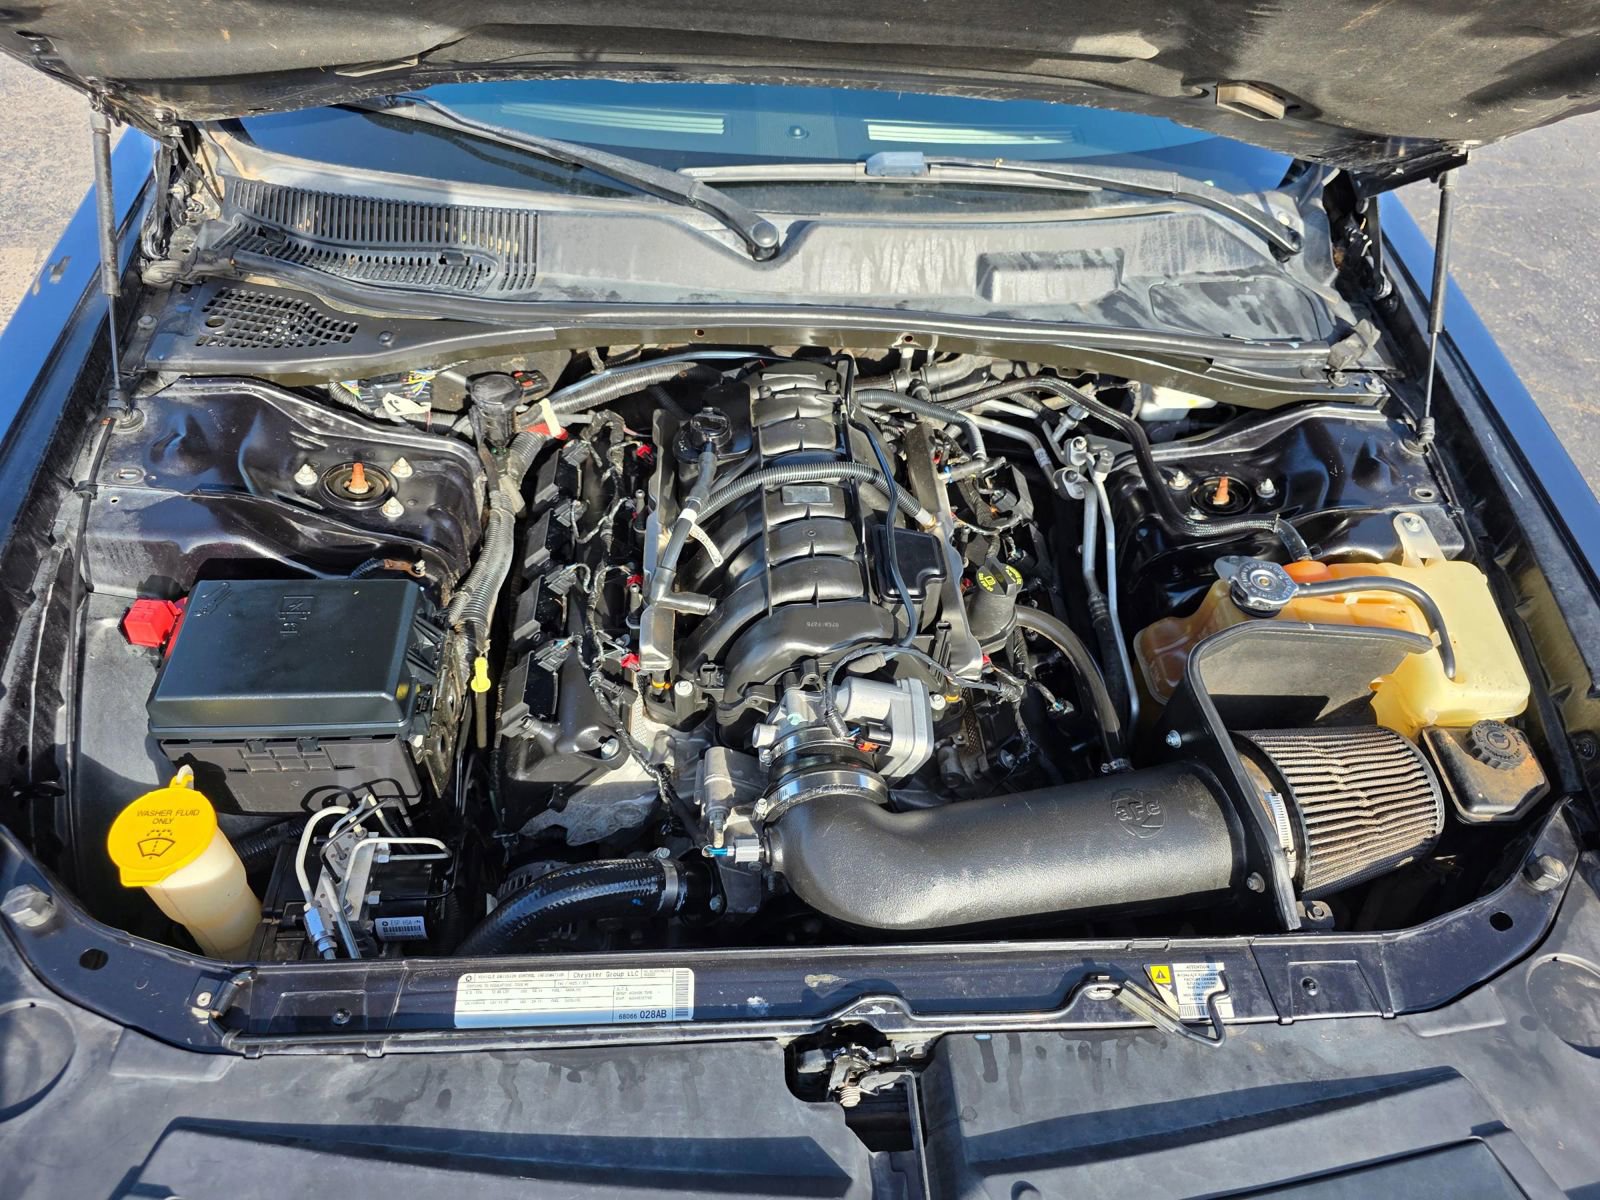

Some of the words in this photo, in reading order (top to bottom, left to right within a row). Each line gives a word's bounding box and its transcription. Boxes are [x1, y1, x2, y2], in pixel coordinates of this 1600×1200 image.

[136, 809, 173, 817] WASHER
[174, 808, 201, 817] FLUID
[573, 971, 603, 979] Chrysler
[639, 1009, 667, 1020] 028AB
